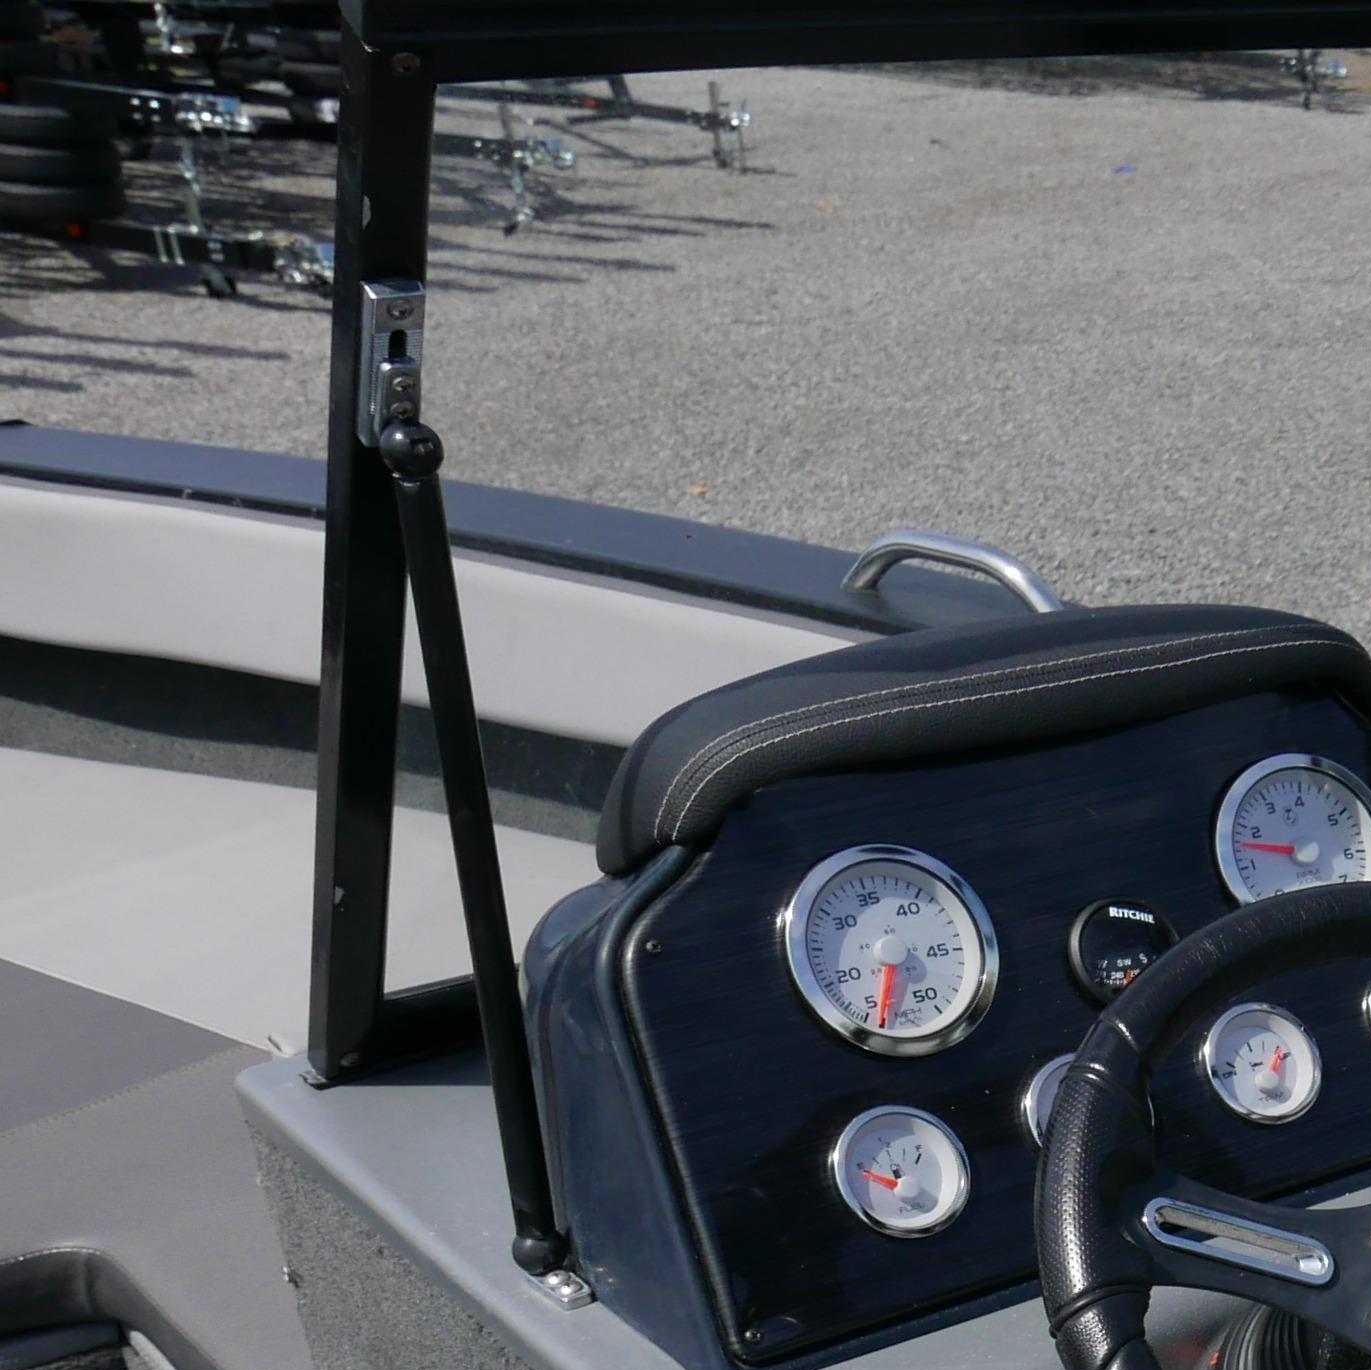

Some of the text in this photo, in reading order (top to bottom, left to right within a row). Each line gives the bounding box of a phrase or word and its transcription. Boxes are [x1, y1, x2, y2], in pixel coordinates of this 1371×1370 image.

[1265, 802, 1276, 815] 3
[1294, 796, 1305, 807] 4
[1328, 813, 1339, 826] 5
[1250, 826, 1262, 839] 2
[1344, 848, 1354, 860] 6
[1250, 858, 1256, 871] 1
[856, 891, 880, 907] 35
[896, 902, 920, 917] 40
[1109, 906, 1155, 924] RITCHIE
[833, 914, 857, 931] 30
[926, 943, 950, 959] 45
[836, 967, 861, 984] 20
[865, 995, 878, 1009] 5
[912, 987, 937, 1004] 50
